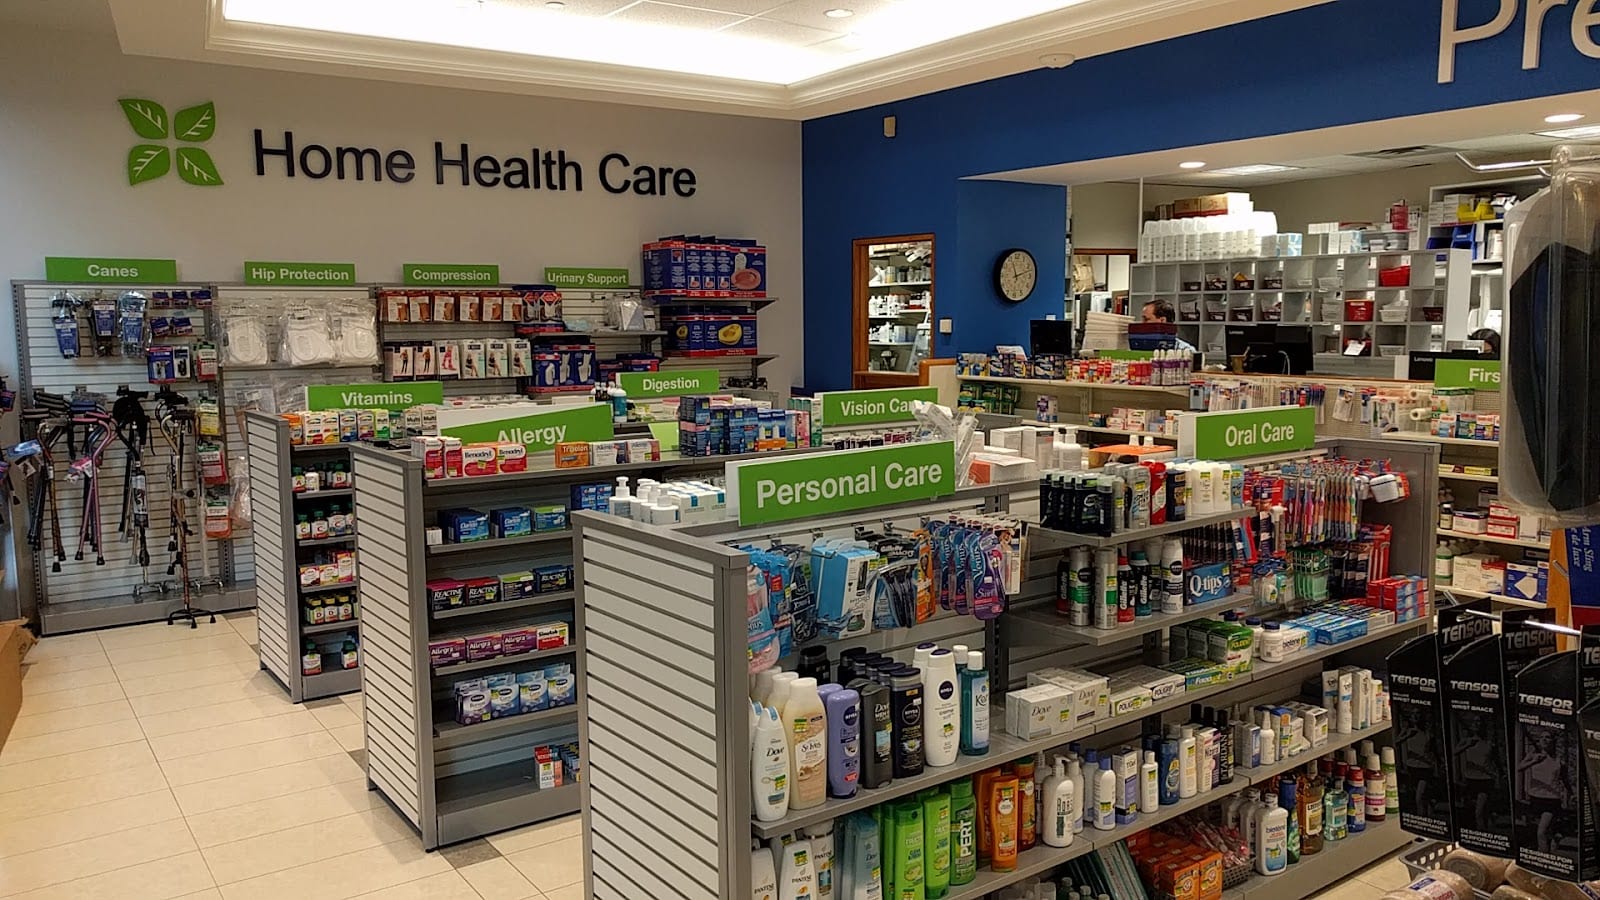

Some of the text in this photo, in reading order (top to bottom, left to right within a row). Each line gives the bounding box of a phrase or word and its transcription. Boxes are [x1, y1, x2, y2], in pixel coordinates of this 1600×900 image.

[253, 128, 697, 198] Home Health Care
[87, 263, 139, 279] Canes
[252, 266, 350, 283] Hip Protection
[412, 268, 491, 285] Compression
[547, 272, 627, 287] Urinary Support
[1469, 367, 1501, 383] Firs
[642, 376, 700, 393] Digestion
[341, 390, 414, 407] Vitamins
[840, 397, 914, 417] Vision Car
[497, 423, 567, 446] Allergy
[1225, 422, 1295, 448] Oral Care
[757, 462, 943, 509] Personal Care
[1571, 534, 1581, 546] de
[1572, 546, 1583, 567] luxe
[1582, 527, 1595, 573] Arm Sling
[972, 546, 984, 580] Venus
[469, 586, 499, 595] REACTINE
[1140, 574, 1148, 605] Gillette
[1189, 574, 1223, 598] Q-tips
[1119, 580, 1128, 610] Gillette
[1442, 619, 1491, 645] TENSOR
[1505, 630, 1555, 650] TENSOR
[1390, 673, 1437, 688] TENSOR
[1450, 680, 1500, 693] TENSOR
[1079, 688, 1096, 701] Dove
[1410, 698, 1432, 706] BRACE
[1518, 693, 1574, 710] TENSOR
[875, 702, 889, 713] Dov
[1031, 705, 1052, 717] Dove
[1540, 720, 1566, 730] BRACE
[766, 746, 785, 757] Dove
[960, 820, 973, 857] PERT
[1519, 846, 1573, 864] DESIGNED FOR
[1519, 853, 1575, 871] PERFORMANCE
[792, 874, 812, 883] PANTENE
[753, 882, 775, 894] PANTENE
